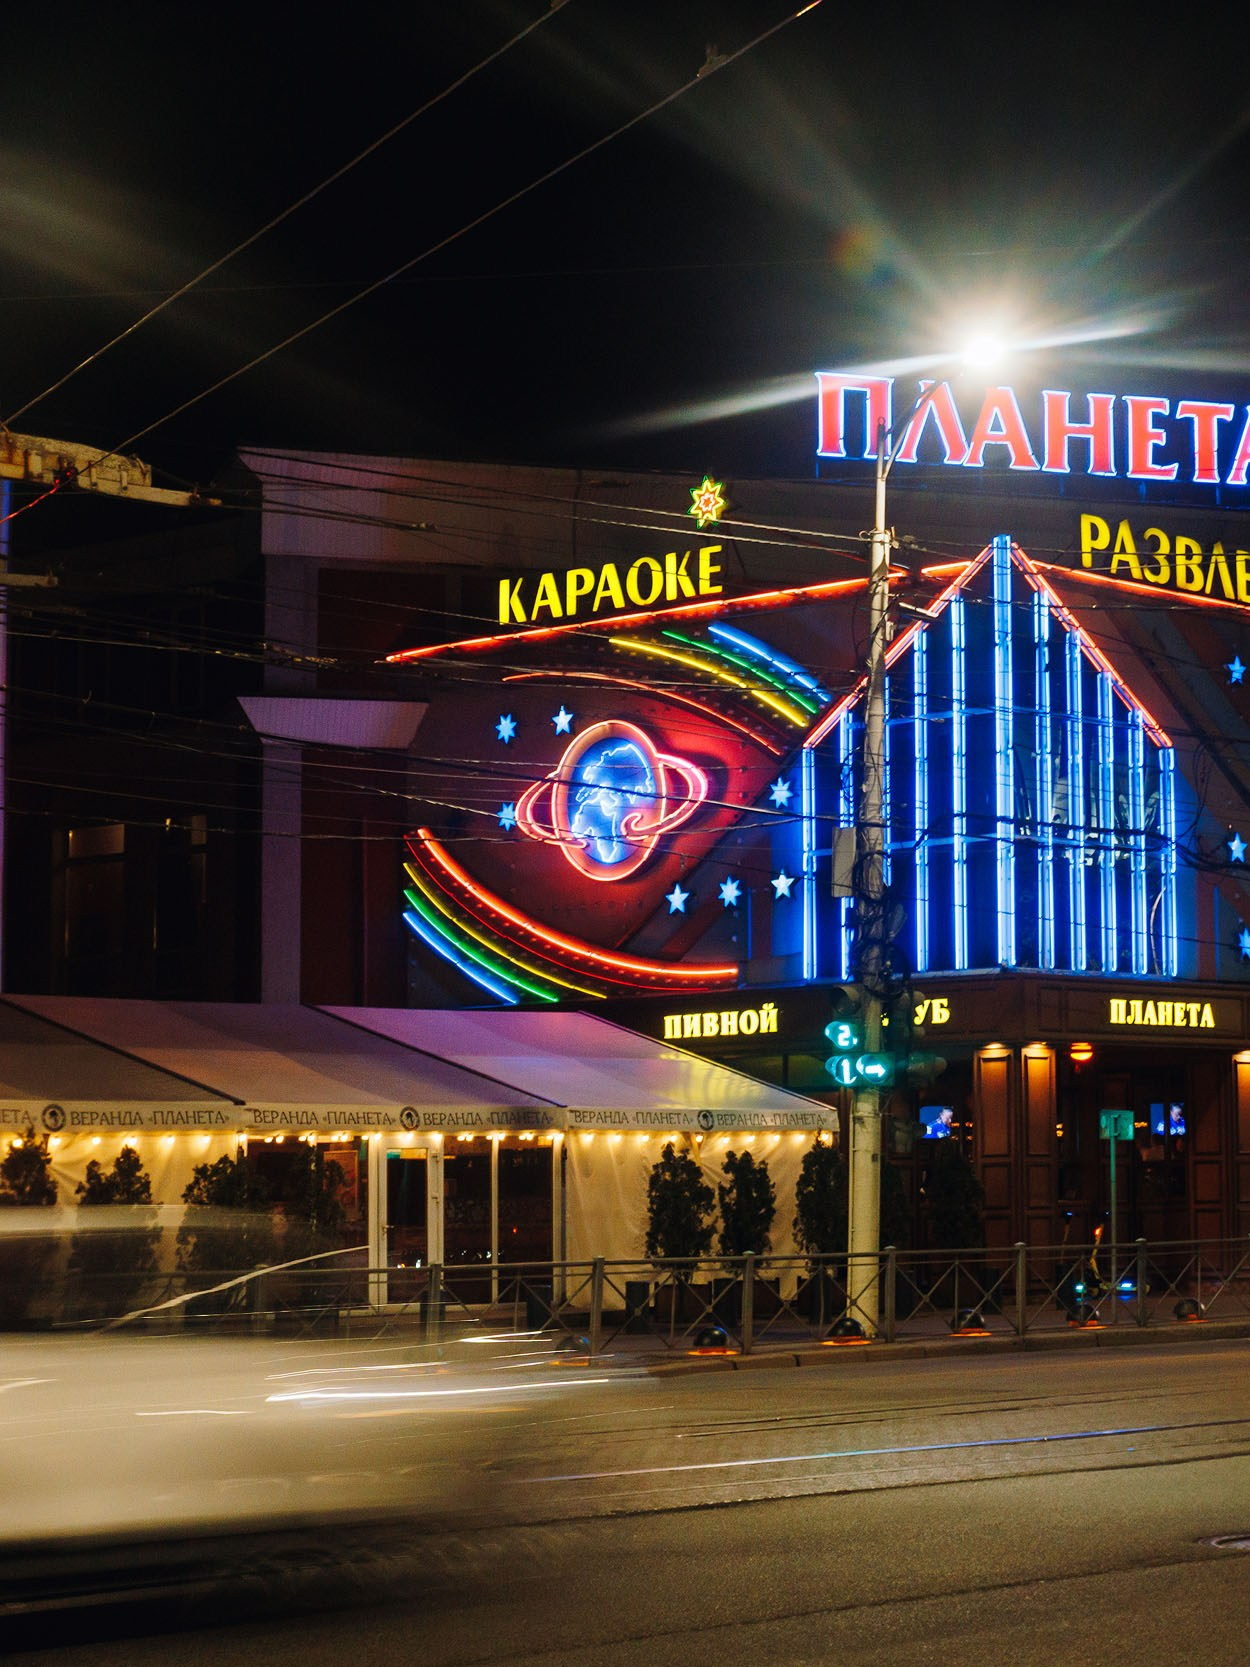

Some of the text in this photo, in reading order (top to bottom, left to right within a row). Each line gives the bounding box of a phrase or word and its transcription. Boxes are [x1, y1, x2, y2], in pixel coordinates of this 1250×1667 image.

[499, 545, 722, 625] КАРАОКЕ
[664, 1003, 779, 1039] ПИВНОЙ
[1110, 999, 1215, 1028] ПЛАНЕТА
[71, 1111, 143, 1126] ВЕРАНДА
[254, 1109, 319, 1125] ВЕРАНДА
[423, 1112, 483, 1126] ВЕРАНДА
[574, 1111, 629, 1124] ВЕРАНДА
[717, 1113, 768, 1126] ВЕРАНДА
